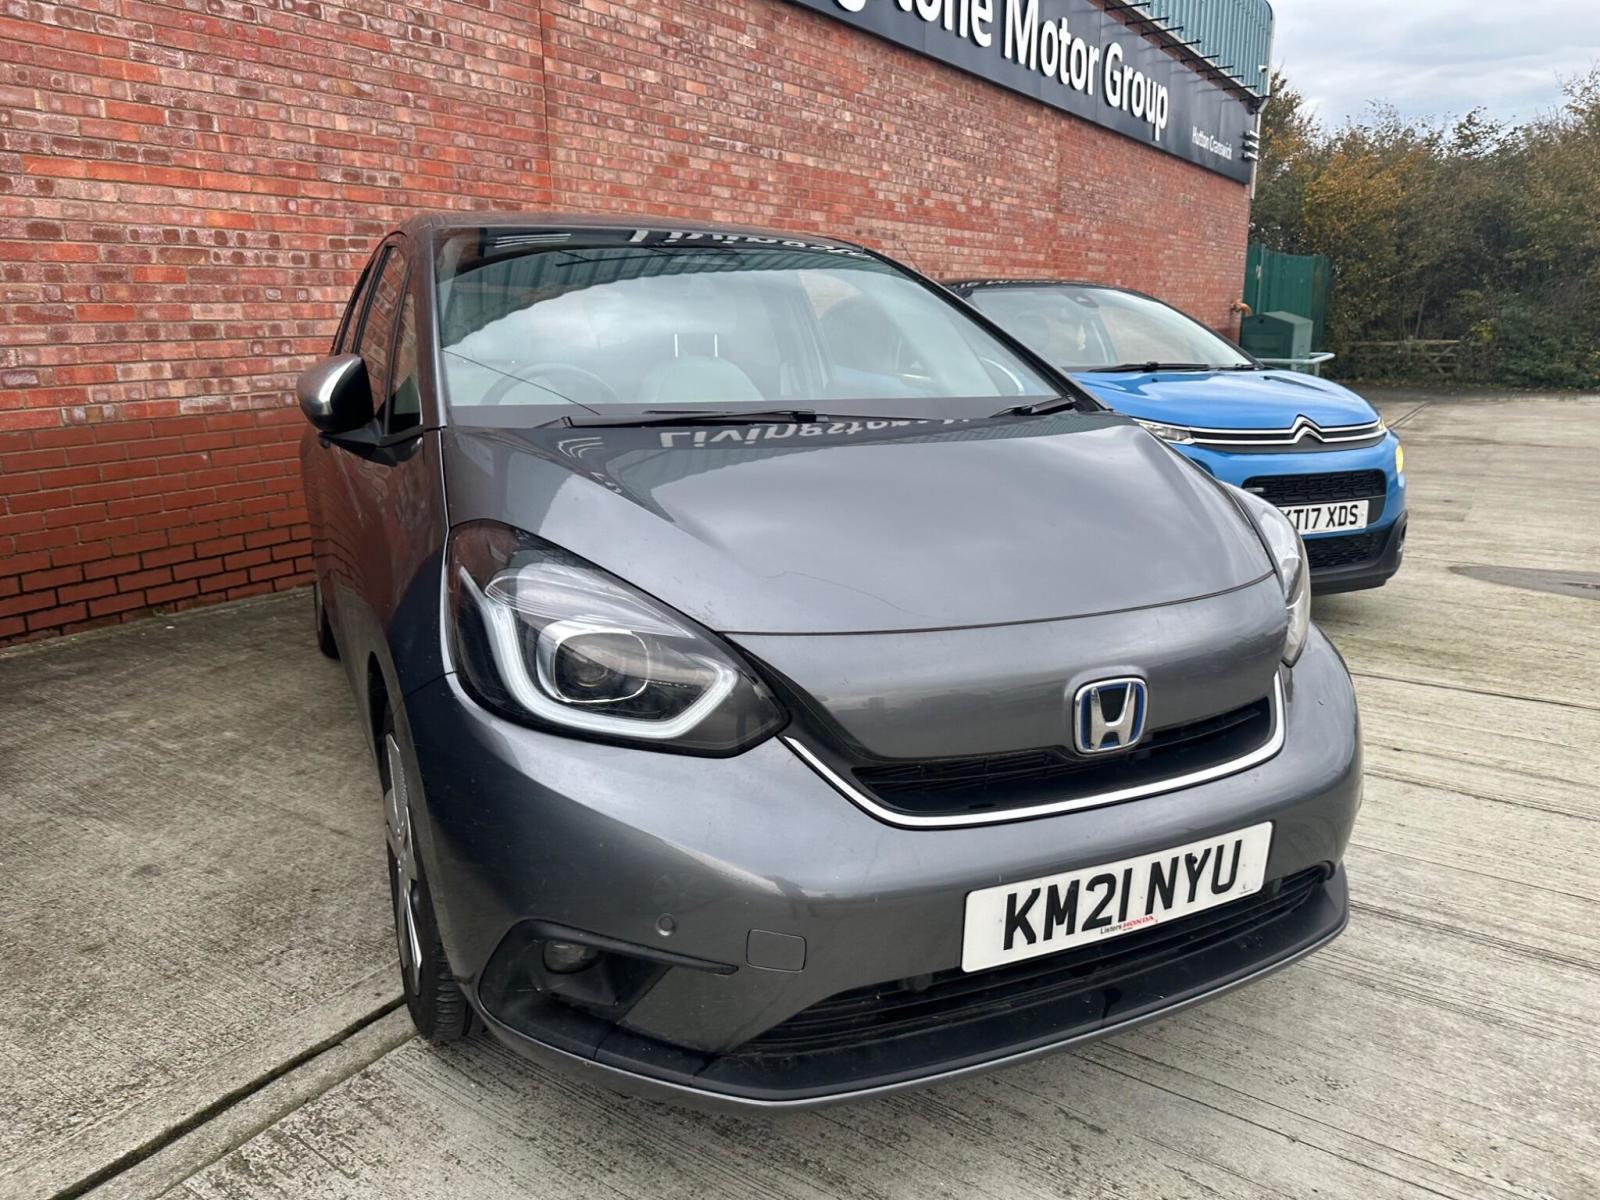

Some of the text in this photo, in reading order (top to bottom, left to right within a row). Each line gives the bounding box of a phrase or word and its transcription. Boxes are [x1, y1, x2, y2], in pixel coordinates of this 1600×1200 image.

[1004, 0, 1099, 95] Motor
[1105, 42, 1168, 141] Group
[1326, 504, 1358, 528] XDS
[1003, 839, 1242, 951] KM21 NYU
[1122, 915, 1154, 929] HONDA
